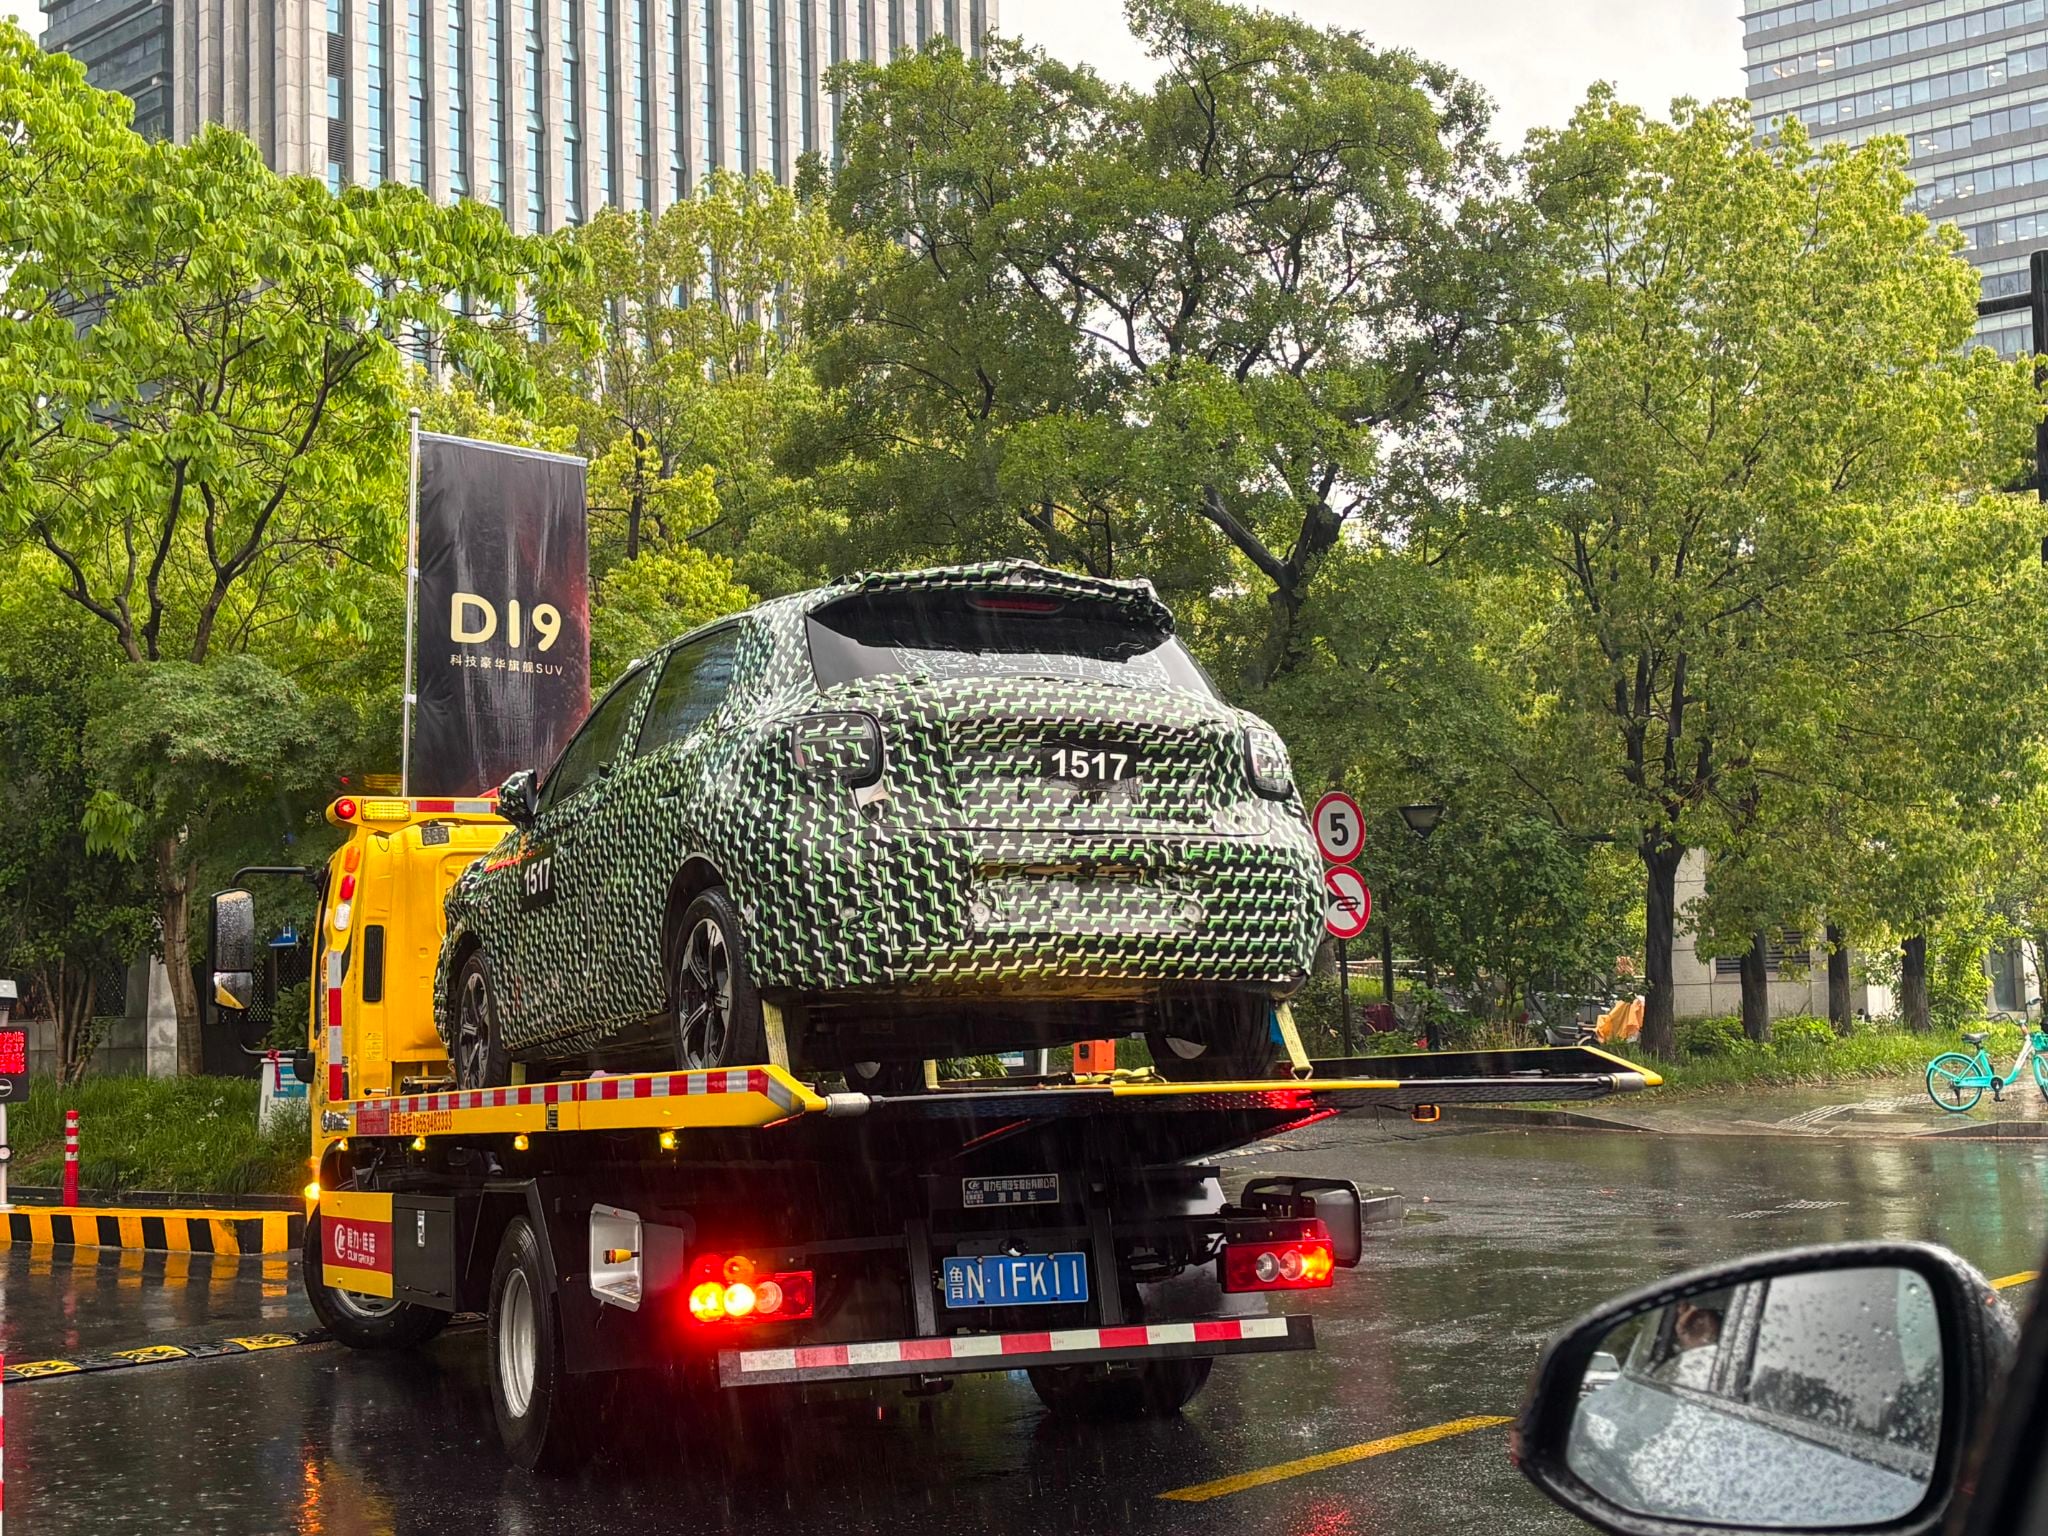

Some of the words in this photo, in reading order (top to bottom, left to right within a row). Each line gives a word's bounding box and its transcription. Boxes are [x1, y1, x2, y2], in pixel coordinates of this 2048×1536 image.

[1051, 749, 1128, 781] 1517
[1330, 812, 1349, 846] 5
[524, 857, 551, 896] 1517
